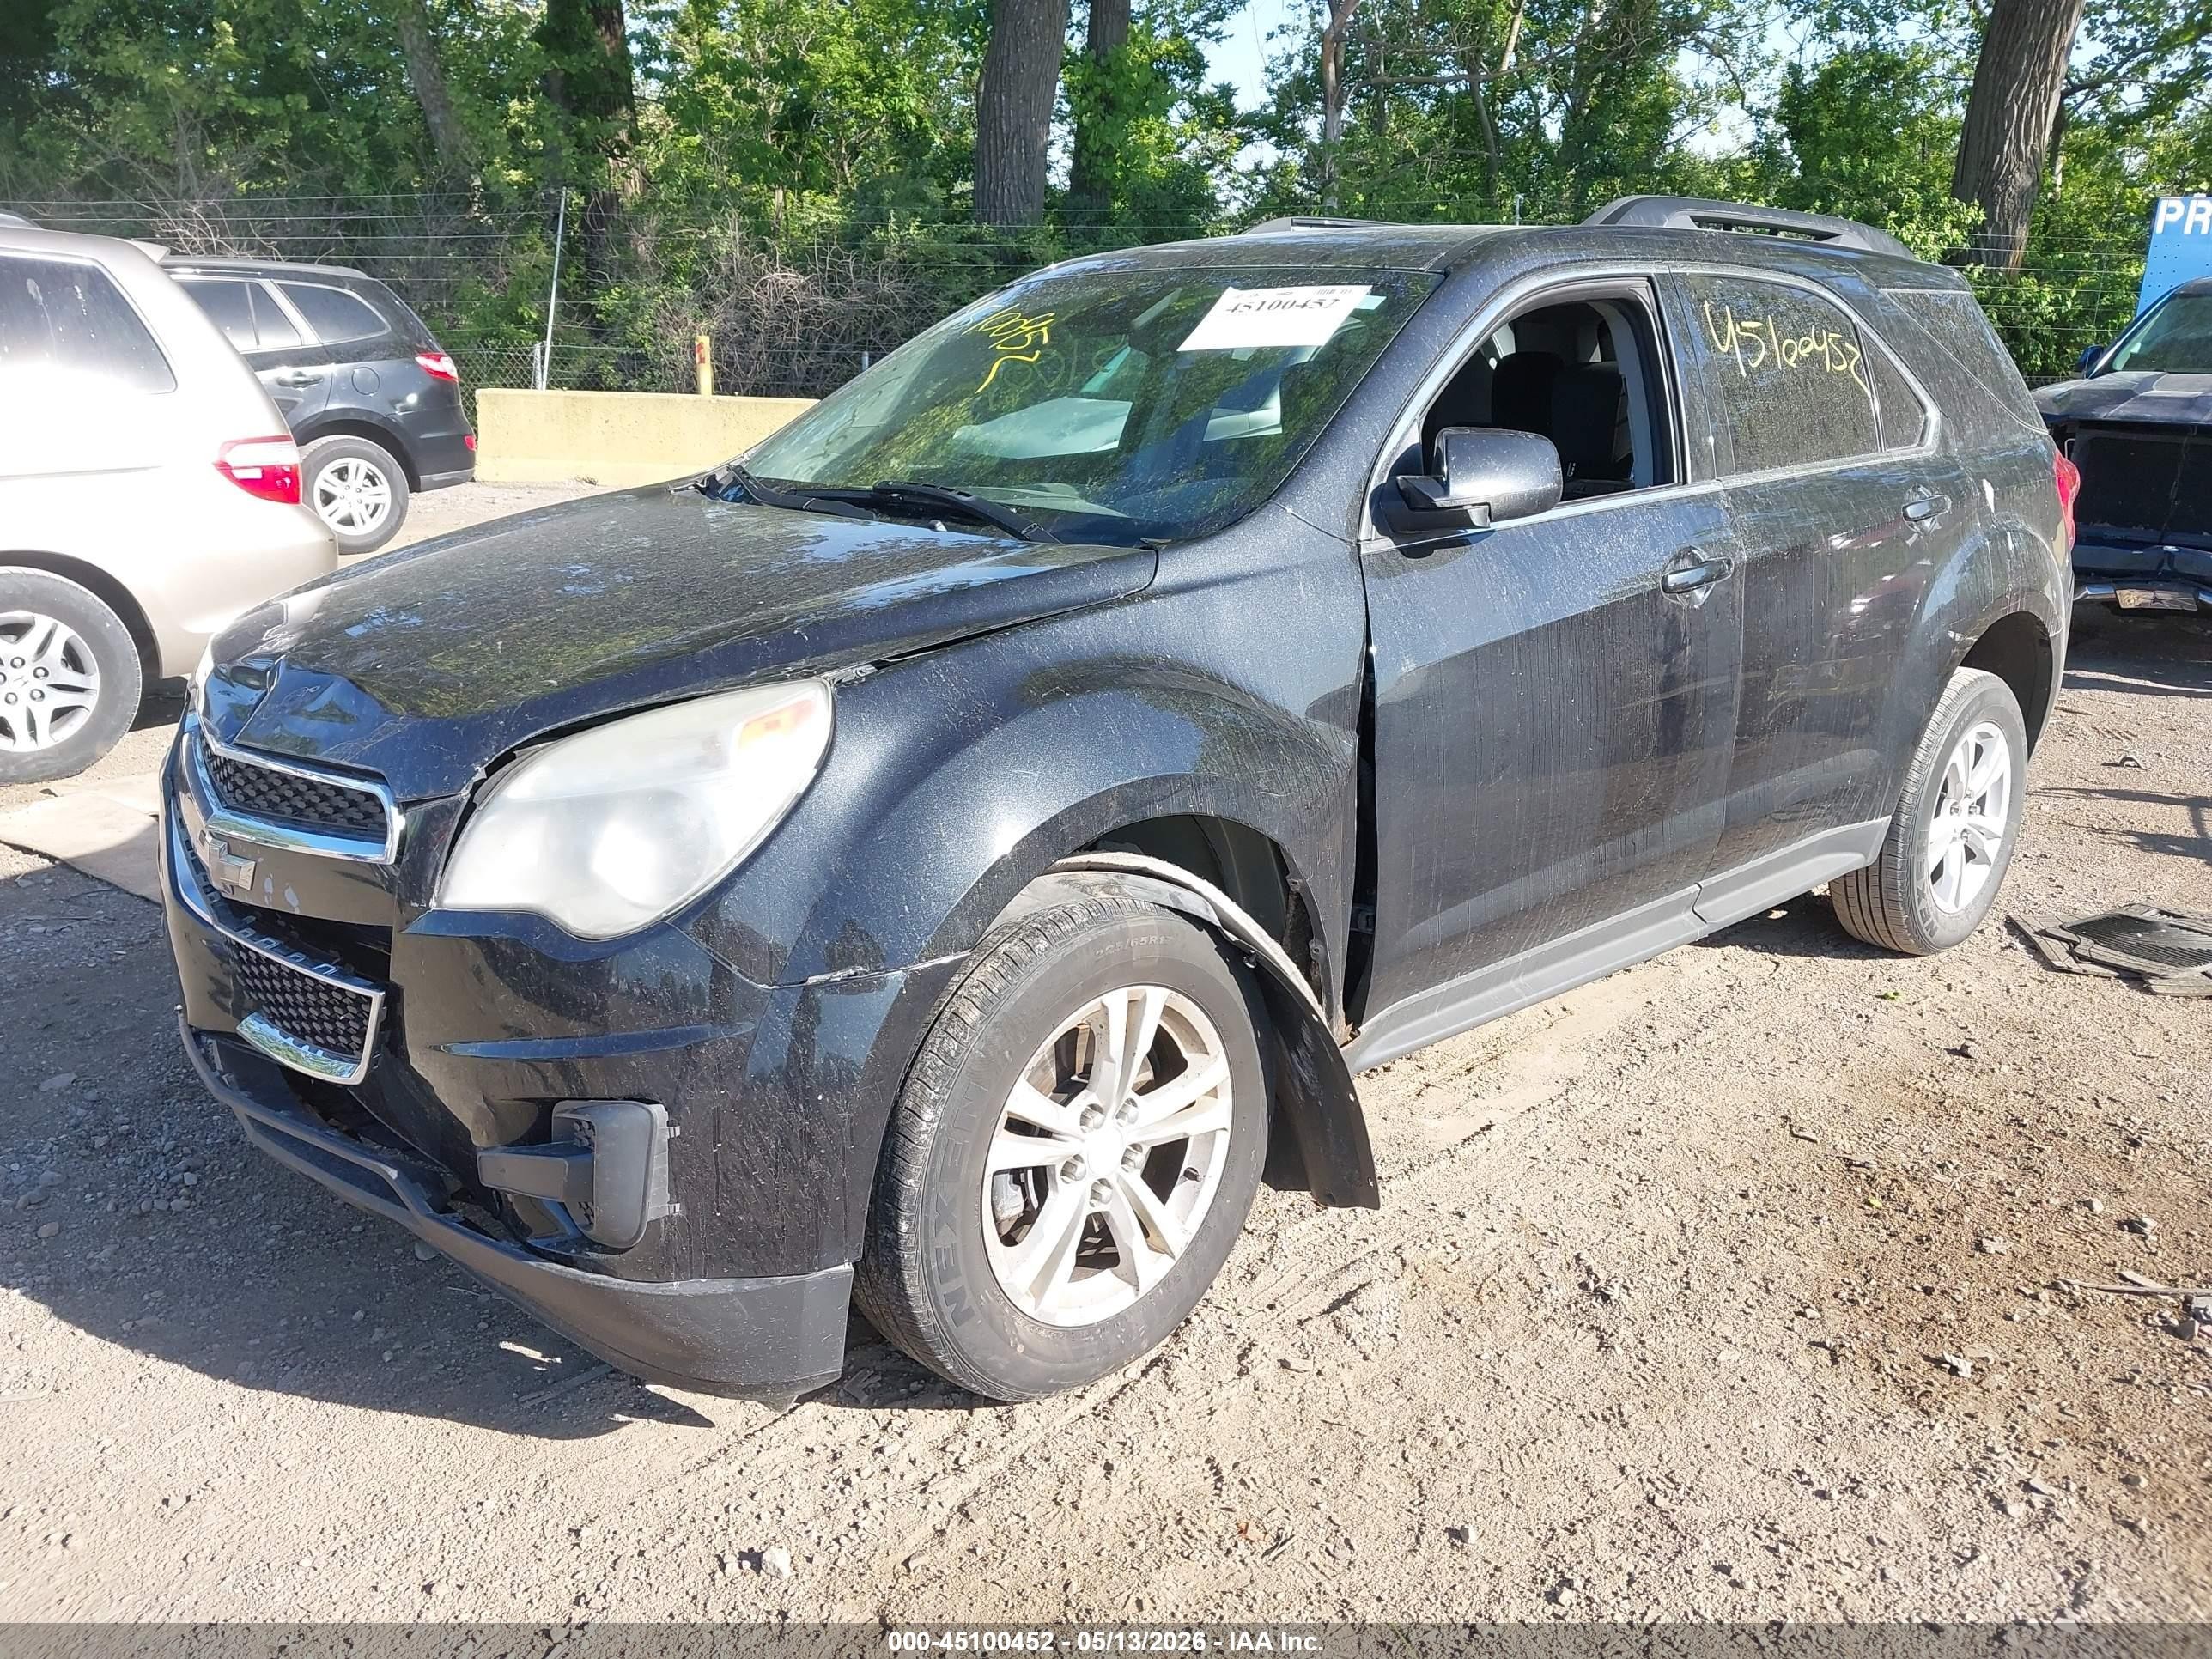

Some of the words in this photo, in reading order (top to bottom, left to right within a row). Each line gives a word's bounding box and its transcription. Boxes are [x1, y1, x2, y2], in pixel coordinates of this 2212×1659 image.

[2155, 198, 2212, 234] PR
[1226, 298, 1340, 313] 45100452
[933, 1081, 989, 1328] NEXEN
